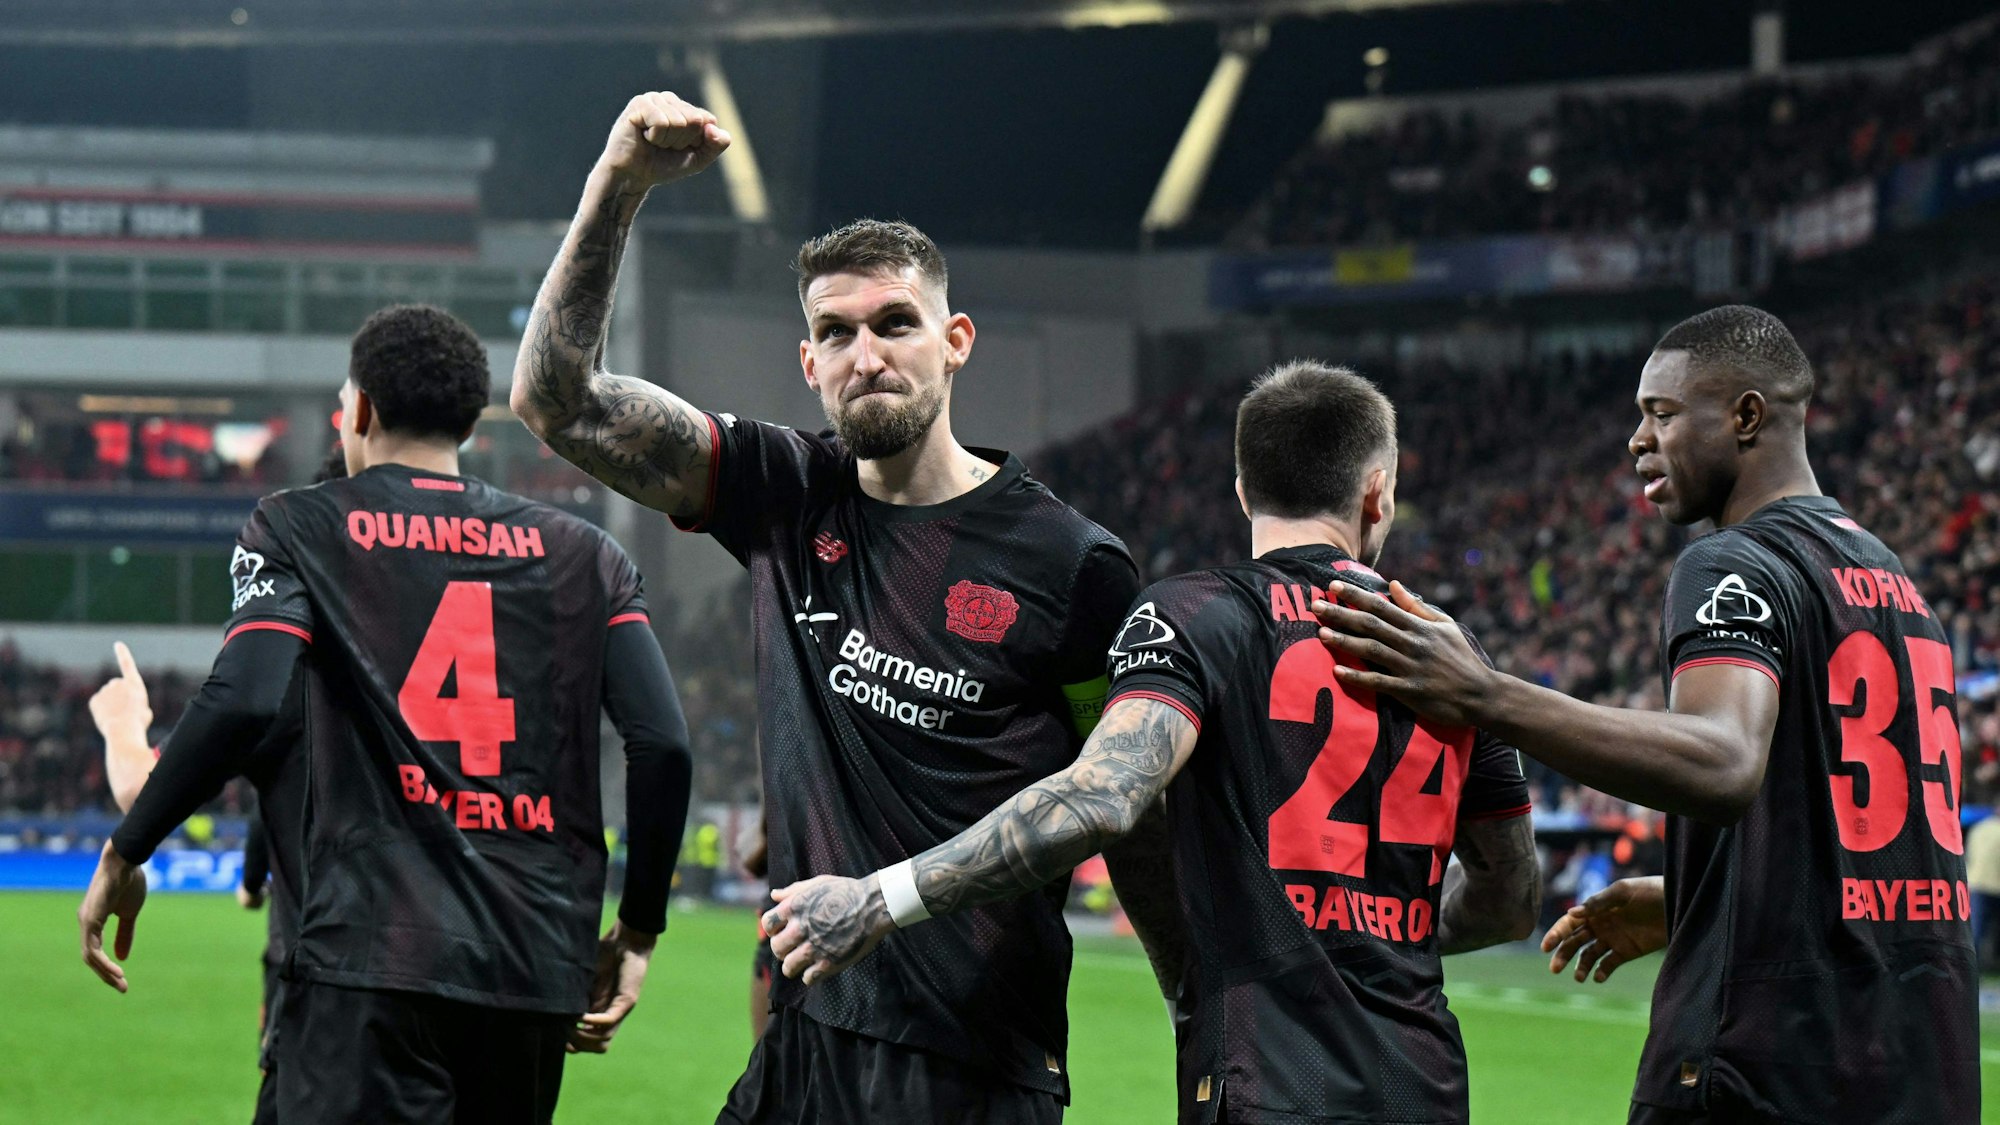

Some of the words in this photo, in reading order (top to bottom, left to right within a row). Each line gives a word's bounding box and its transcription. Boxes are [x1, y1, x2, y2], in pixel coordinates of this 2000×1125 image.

[347, 510, 545, 558] QUANSAH
[398, 581, 516, 776] 4
[828, 663, 953, 730] Gothaer
[838, 628, 985, 703] Barmenia
[1071, 702, 1102, 715] SPE
[1268, 637, 1477, 886] 24
[1827, 630, 1964, 856] 35
[512, 794, 555, 832] 04
[1285, 884, 1403, 942] BAYER
[1408, 898, 1433, 943] 0
[1842, 877, 1953, 921] BAYER
[1956, 880, 1971, 922] 0
